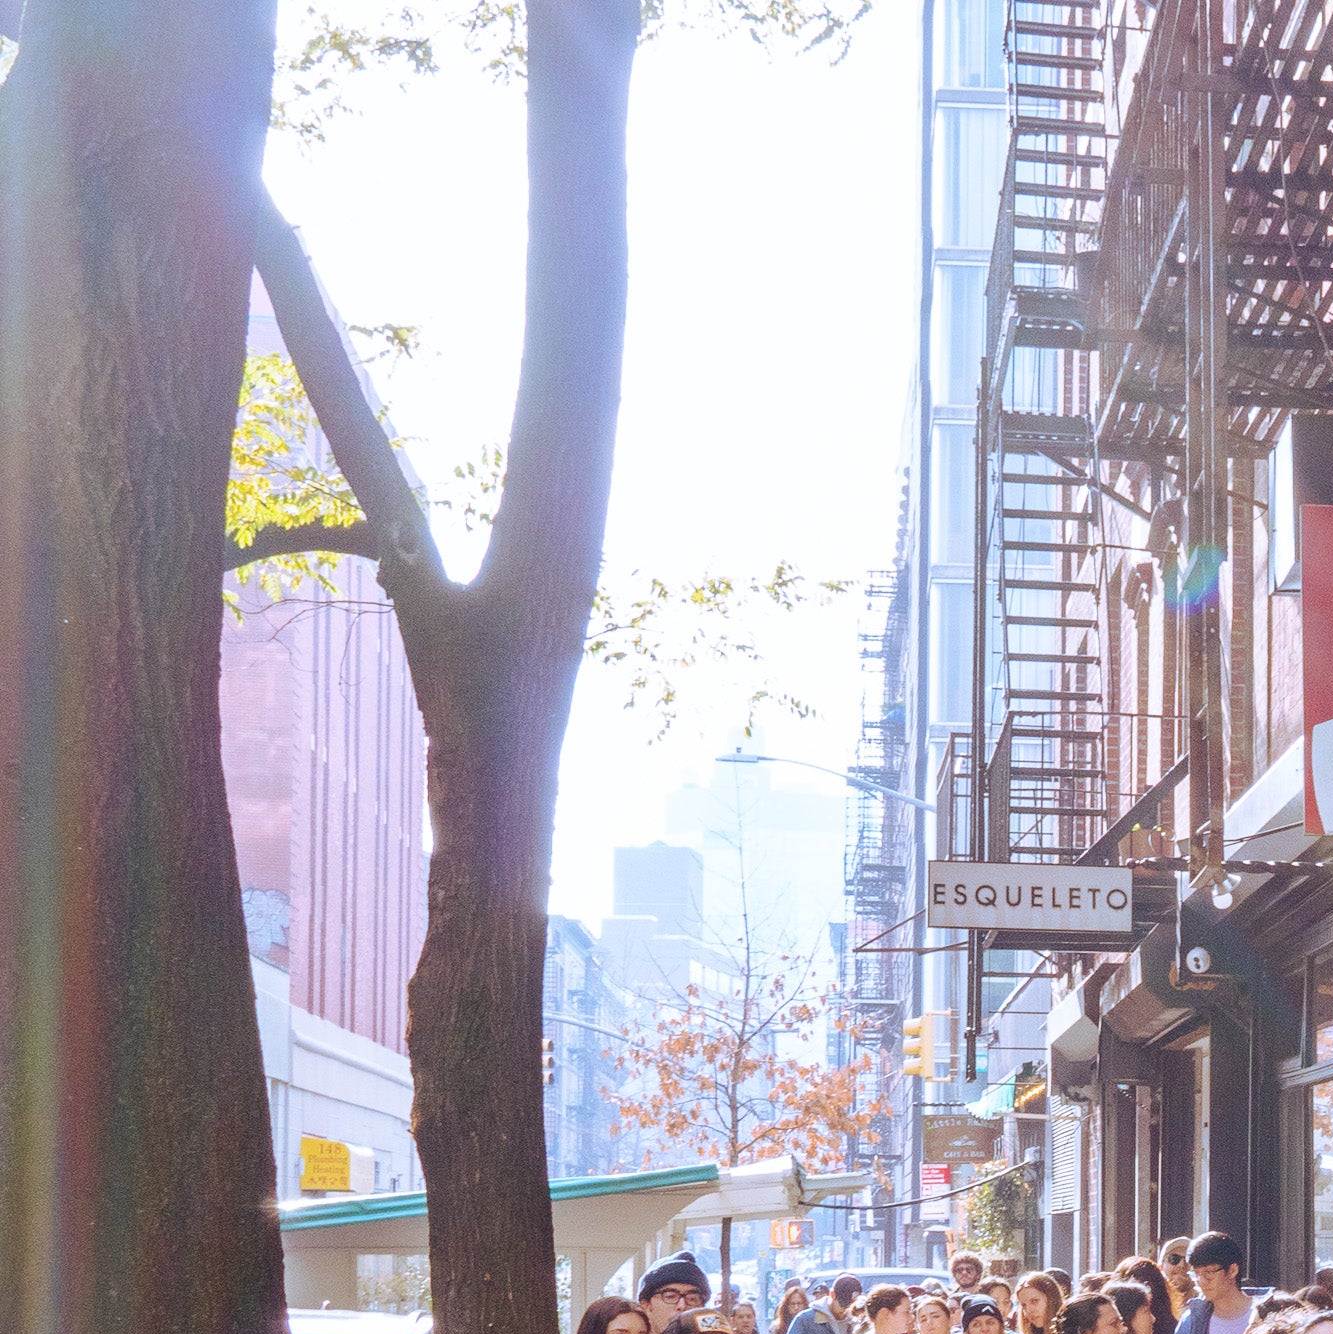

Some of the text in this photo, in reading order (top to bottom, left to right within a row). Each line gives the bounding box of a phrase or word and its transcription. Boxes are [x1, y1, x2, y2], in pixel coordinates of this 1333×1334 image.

[933, 883, 1128, 910] ESQUELETO
[319, 1143, 342, 1155] 148
[313, 1164, 346, 1175] Heating
